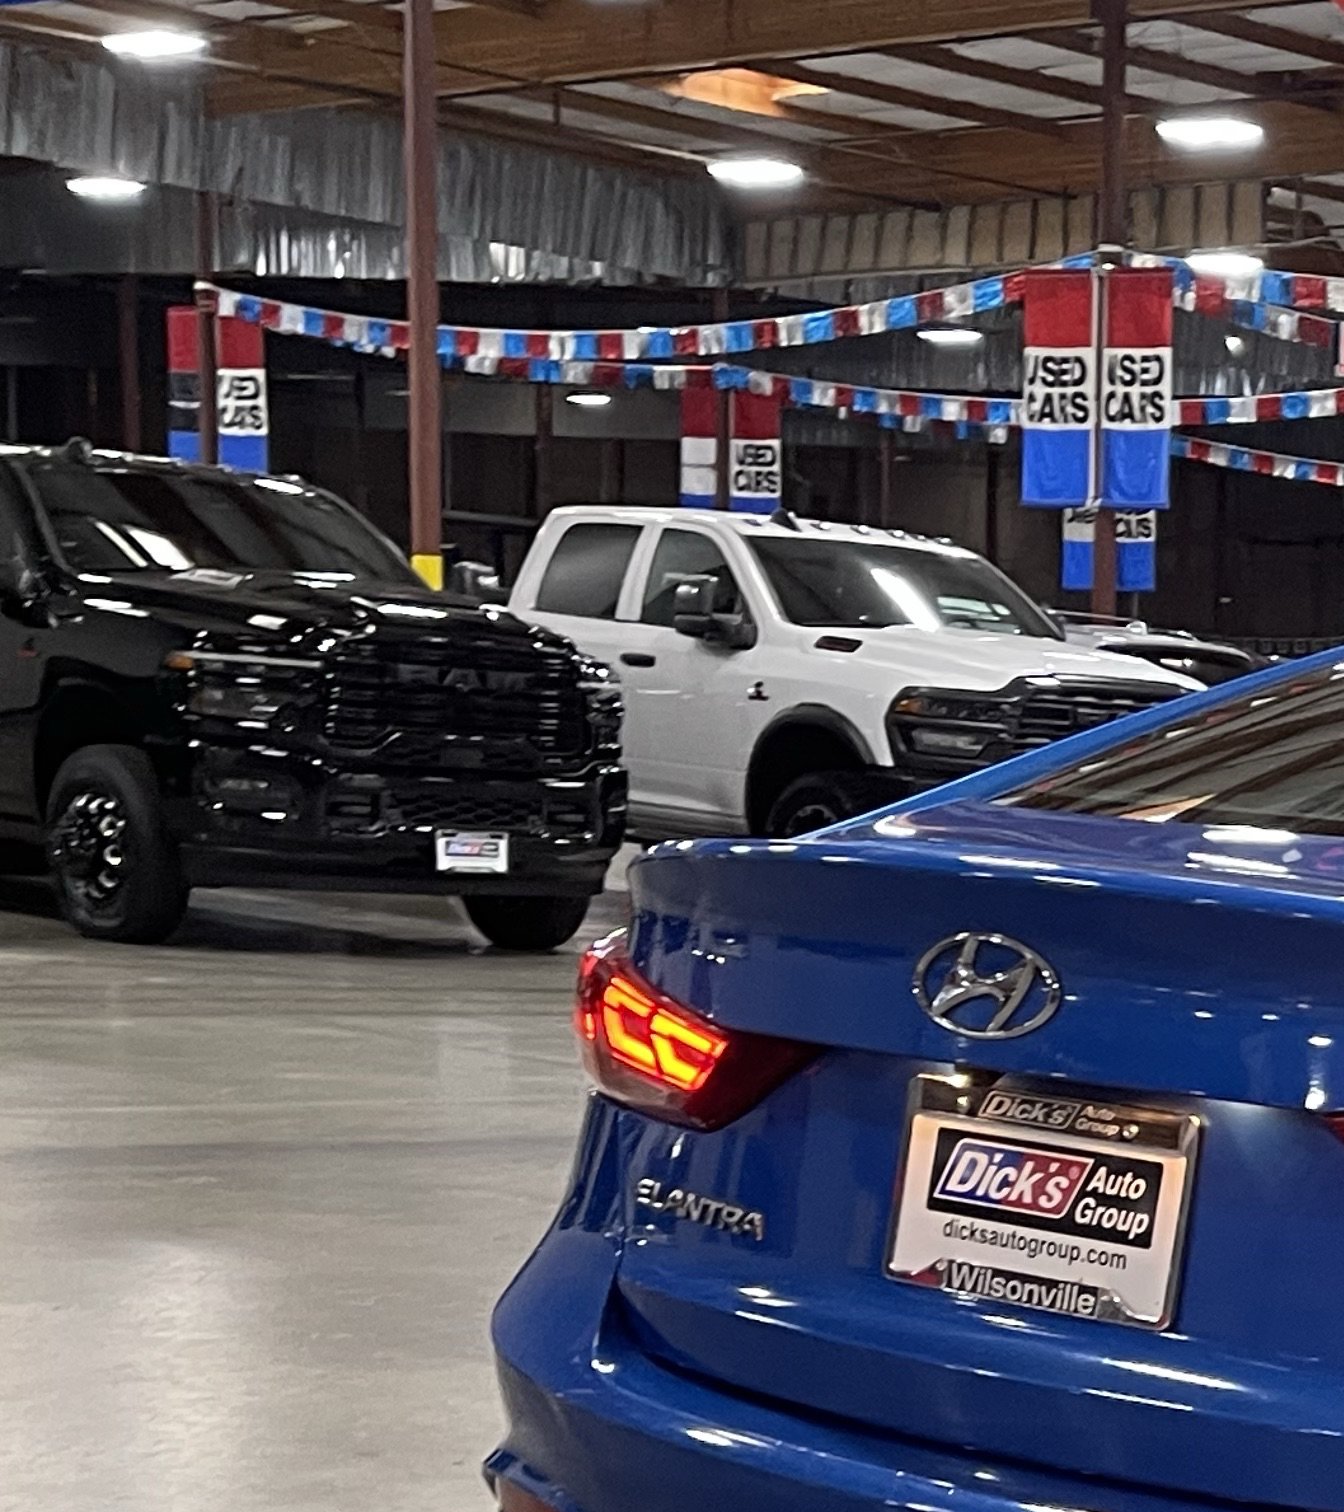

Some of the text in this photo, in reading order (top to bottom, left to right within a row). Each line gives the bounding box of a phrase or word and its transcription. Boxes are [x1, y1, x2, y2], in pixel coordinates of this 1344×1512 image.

[985, 1095, 1068, 1125] Dick's
[1075, 1117, 1120, 1136] Group
[1080, 1105, 1116, 1121] Auto
[944, 1150, 1071, 1210] Dick's
[1086, 1165, 1147, 1200] Auto
[637, 1178, 763, 1241] ELANTRA
[1074, 1197, 1150, 1239] Group
[942, 1218, 1128, 1270] dicksautogroup.com
[950, 1261, 1096, 1315] Wilsonville
